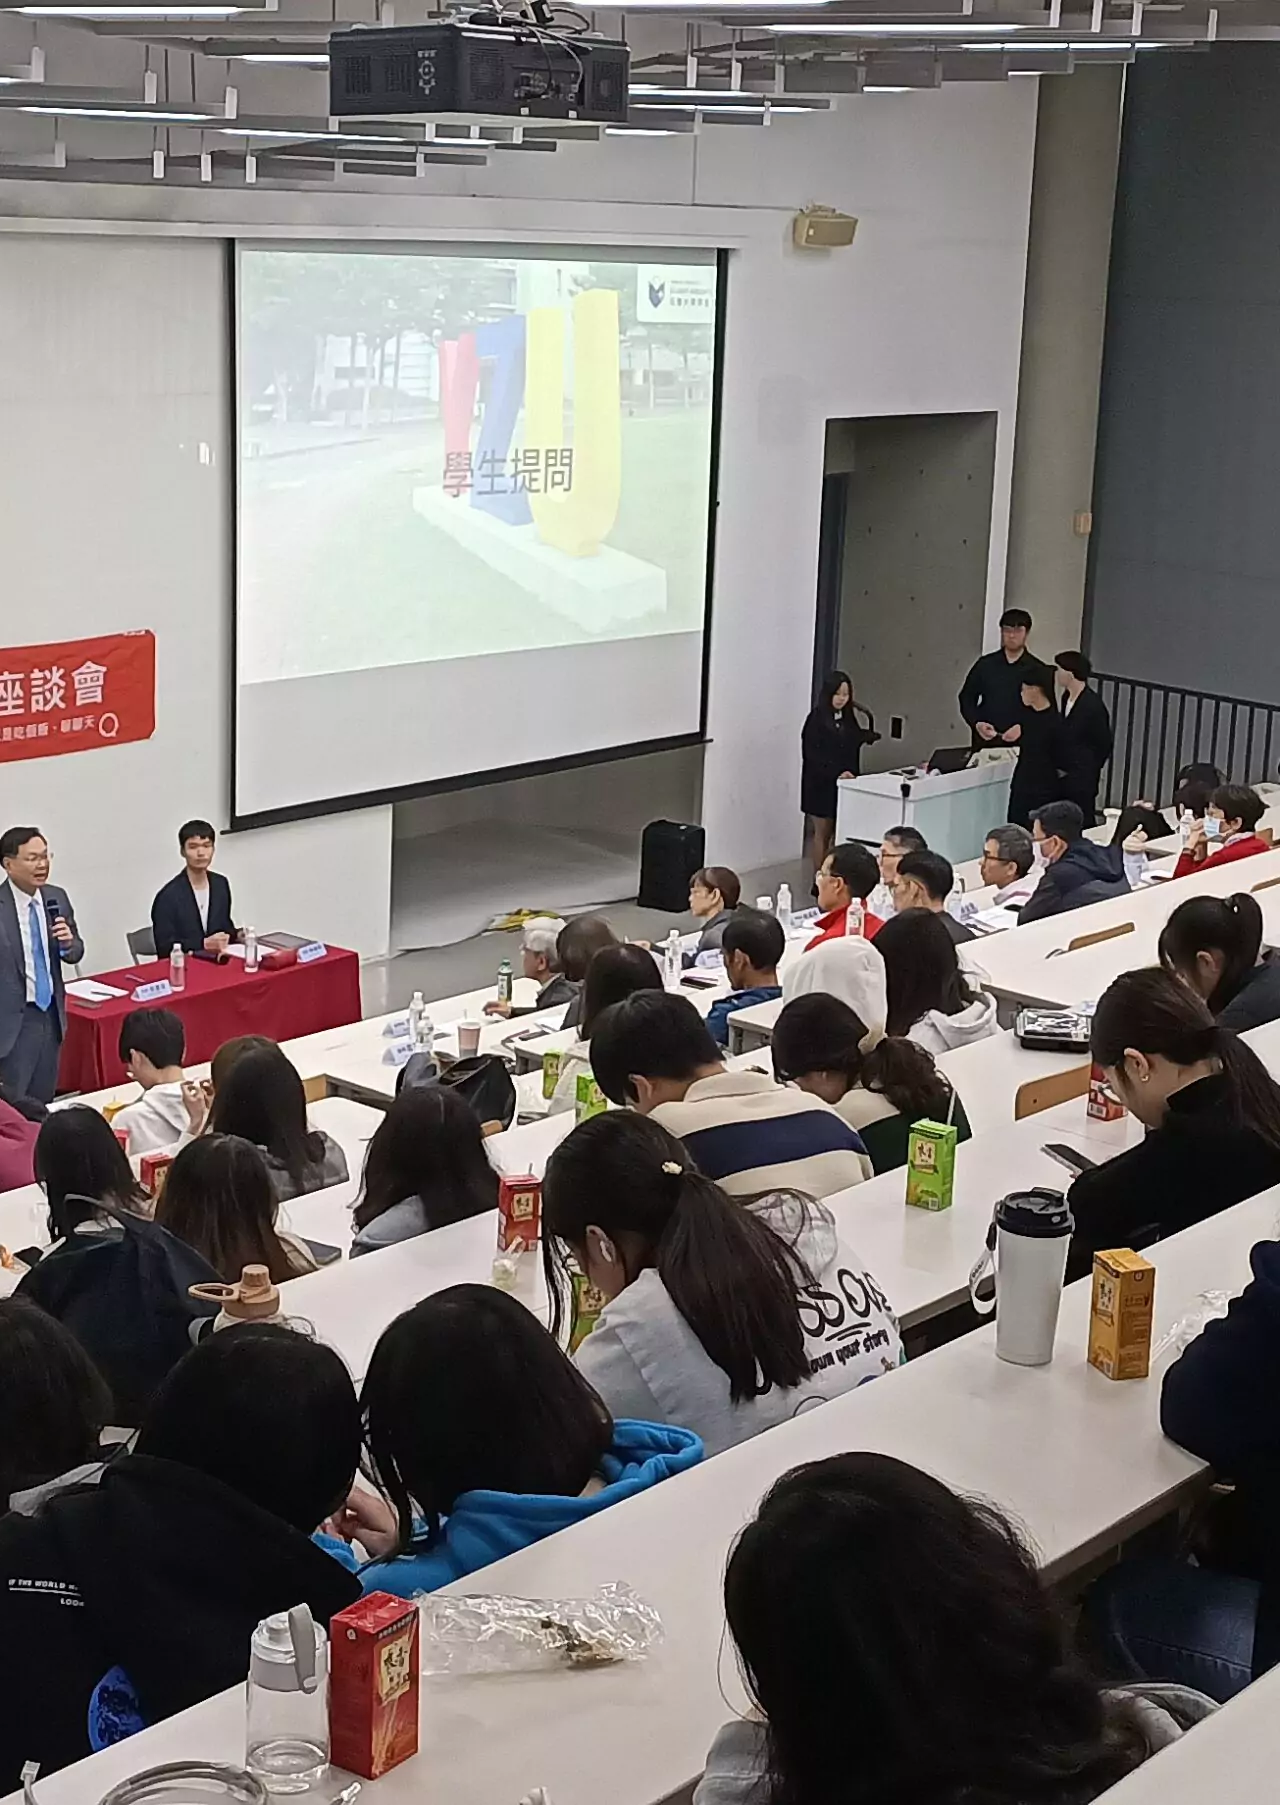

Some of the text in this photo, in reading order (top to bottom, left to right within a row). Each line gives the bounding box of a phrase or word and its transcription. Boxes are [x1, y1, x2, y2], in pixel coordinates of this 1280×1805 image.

[443, 447, 573, 498] 學生提問
[835, 1338, 861, 1366] your
[862, 1328, 890, 1353] story
[34, 1580, 66, 1589] WORLD
